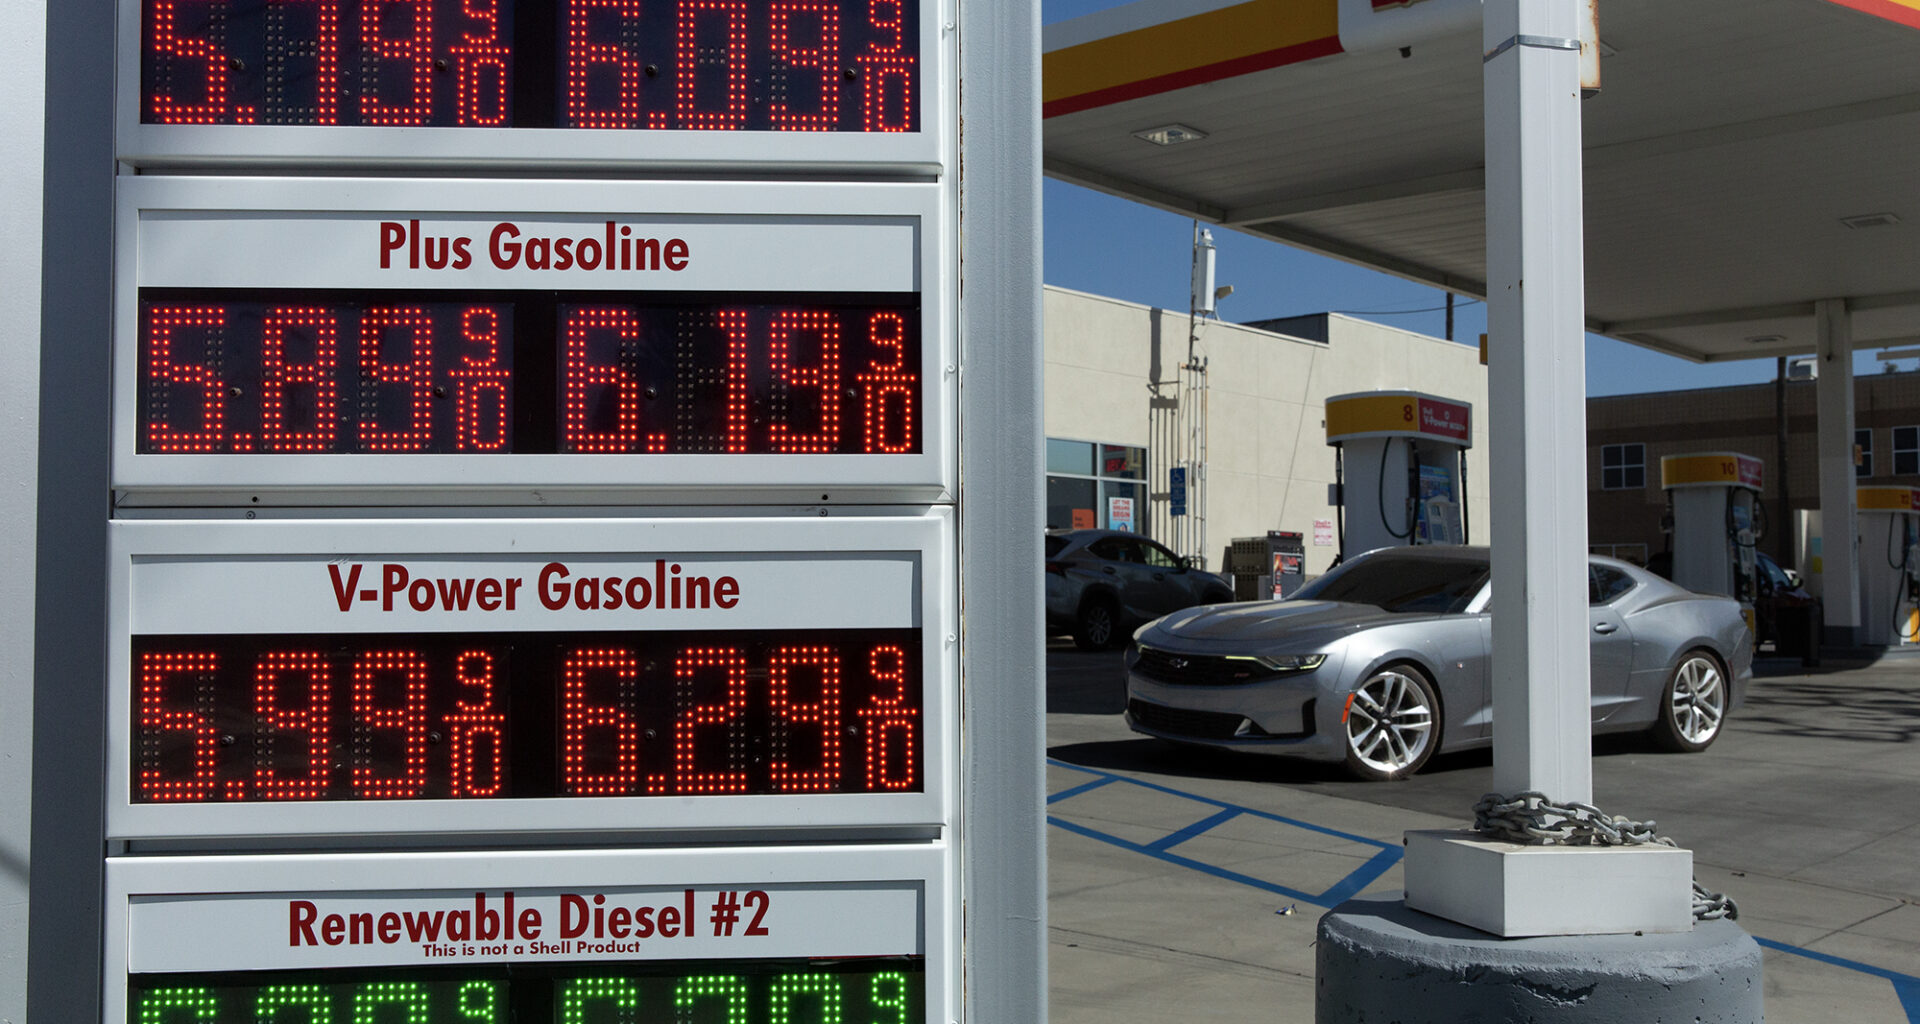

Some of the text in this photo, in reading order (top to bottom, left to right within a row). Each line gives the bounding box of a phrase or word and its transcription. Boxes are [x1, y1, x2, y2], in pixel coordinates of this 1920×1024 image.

[380, 219, 689, 272] Plus Gasoline
[149, 307, 432, 451] 5.89
[566, 309, 840, 453] 6.19
[1403, 404, 1414, 422] 8
[1721, 462, 1735, 475] 10
[327, 559, 740, 613] V-Power Gasoline
[142, 651, 427, 800] 5.99
[565, 646, 841, 794] 6.29
[290, 890, 769, 946] Renewable Diesel #2
[422, 940, 640, 957] This is not a Shell Product
